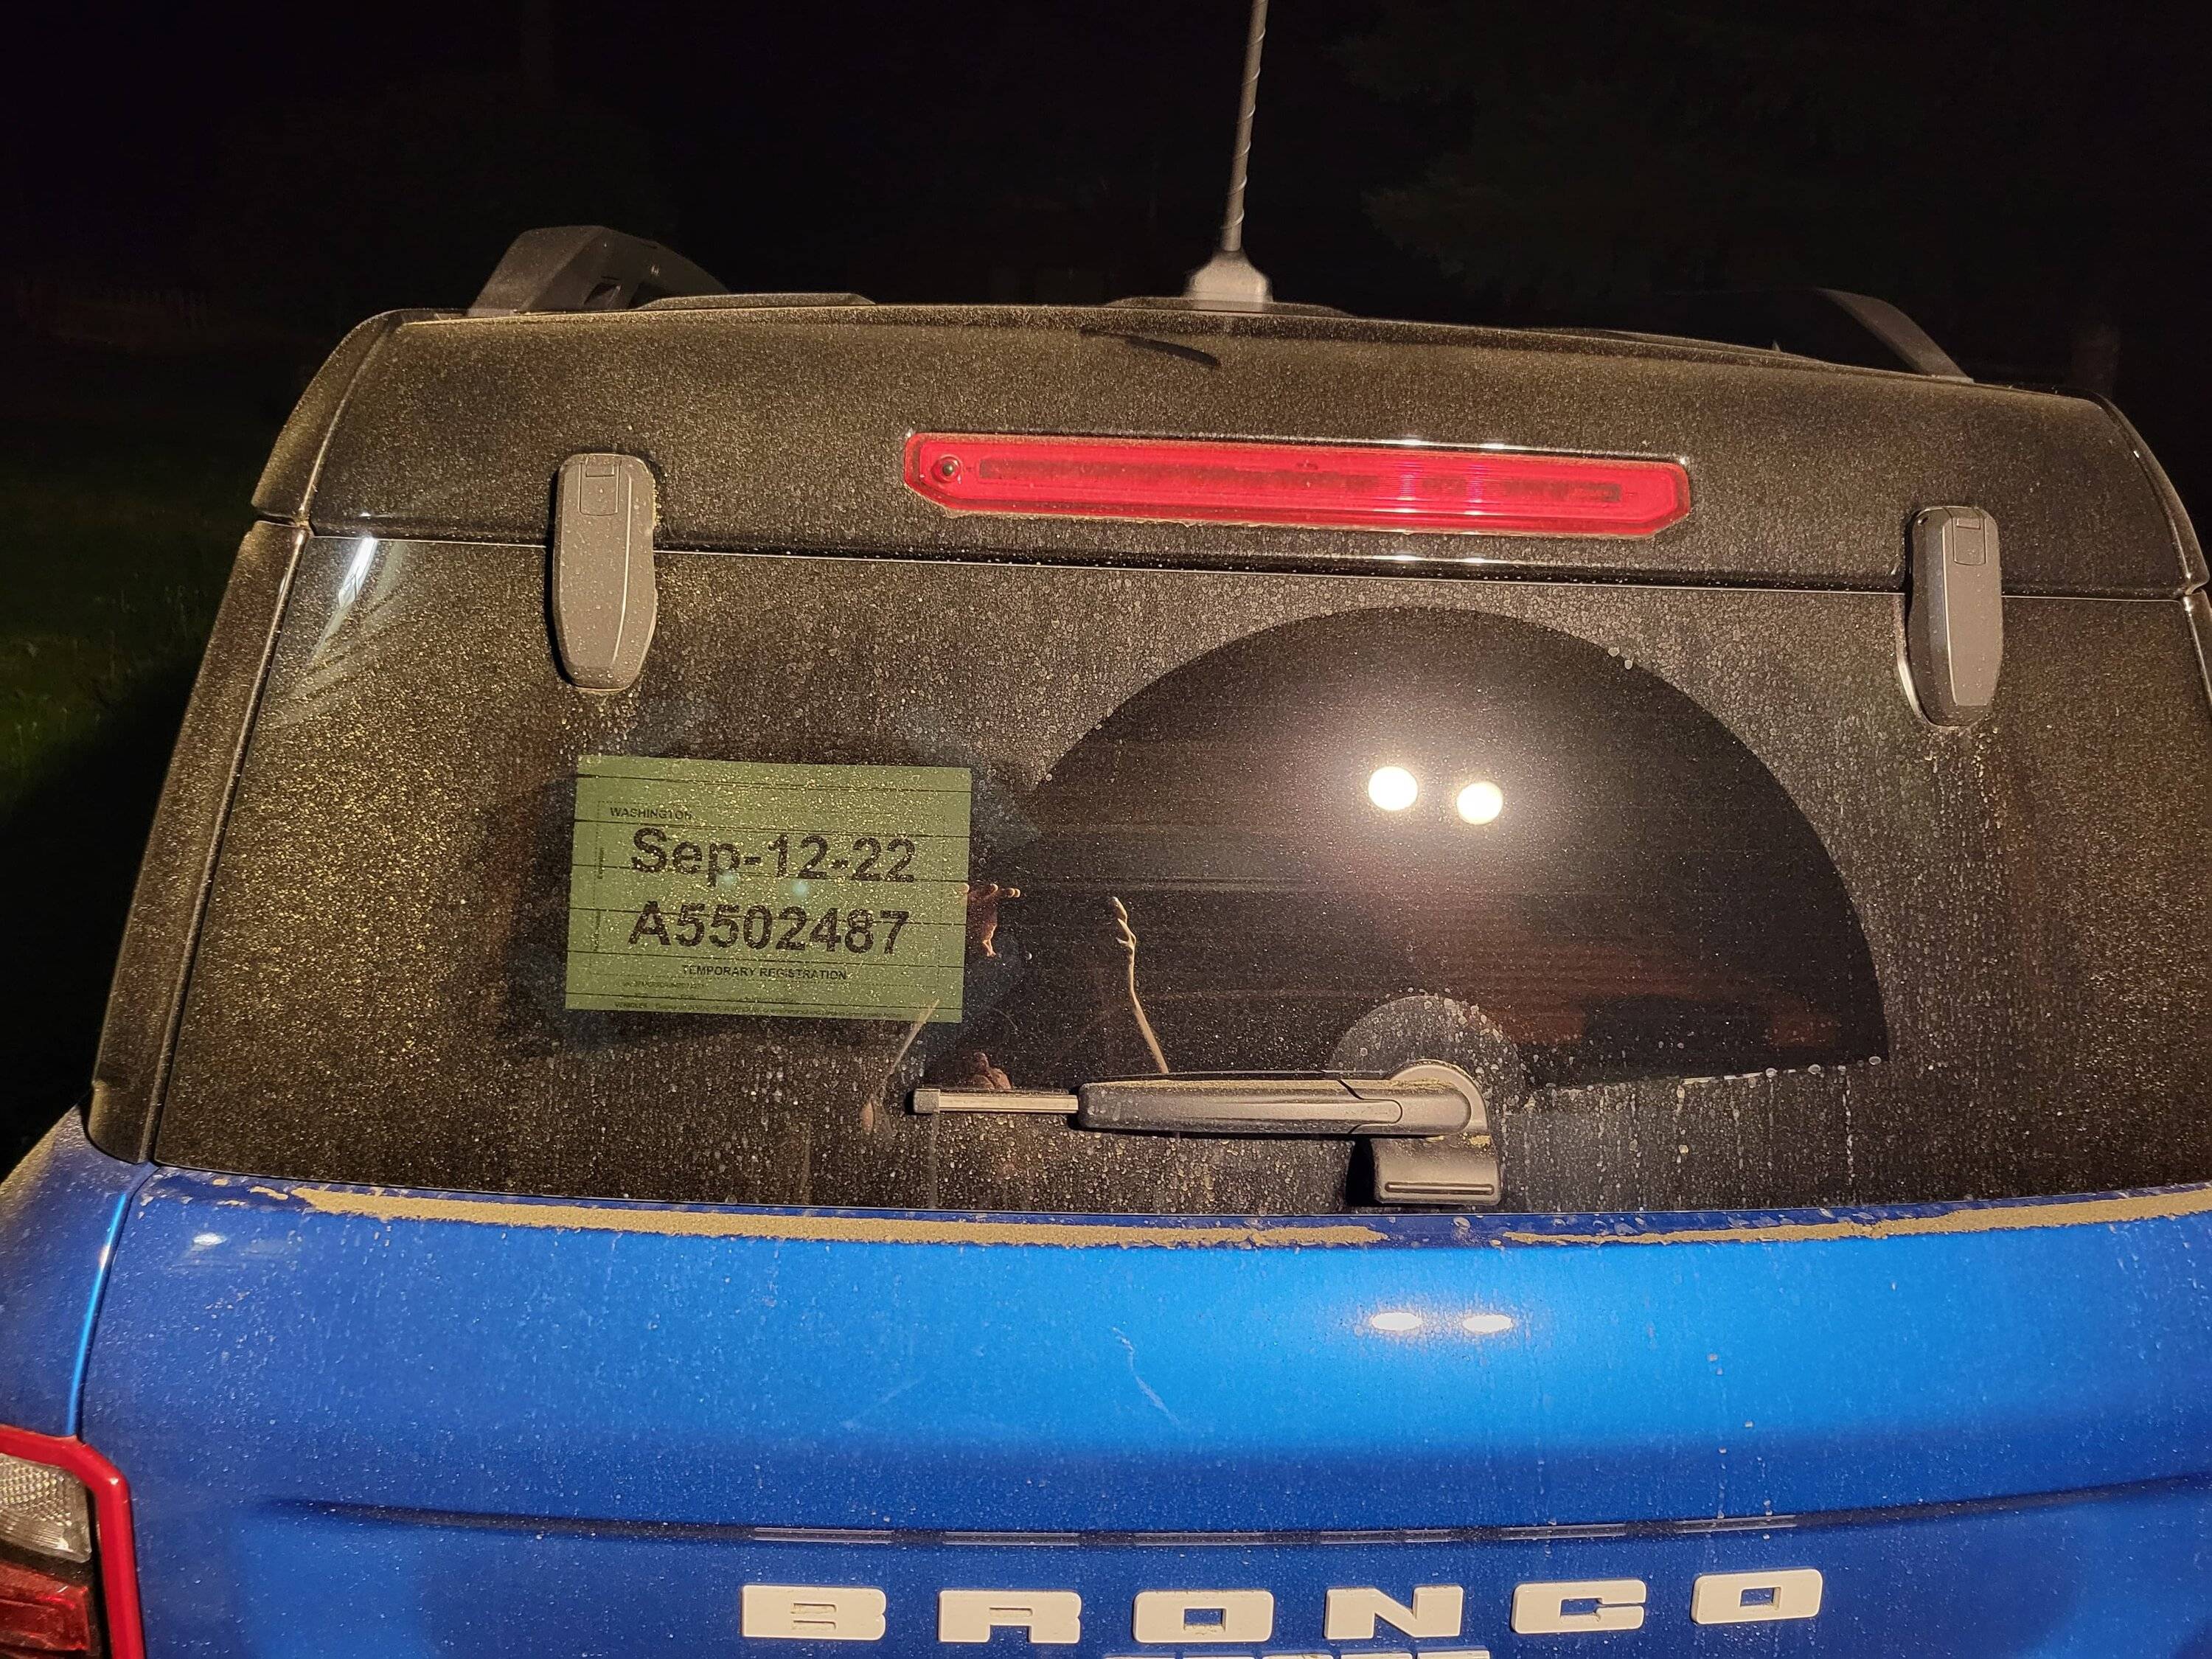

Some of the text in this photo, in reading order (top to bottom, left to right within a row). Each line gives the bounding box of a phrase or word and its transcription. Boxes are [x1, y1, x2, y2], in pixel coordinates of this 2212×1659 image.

[610, 806, 693, 821] WASHINGTON
[631, 827, 916, 887] Sep-12-22
[627, 900, 910, 955] A5502487
[681, 964, 847, 981] TEMPORARY REGISTRATION
[741, 1568, 1823, 1644] BRONCO
